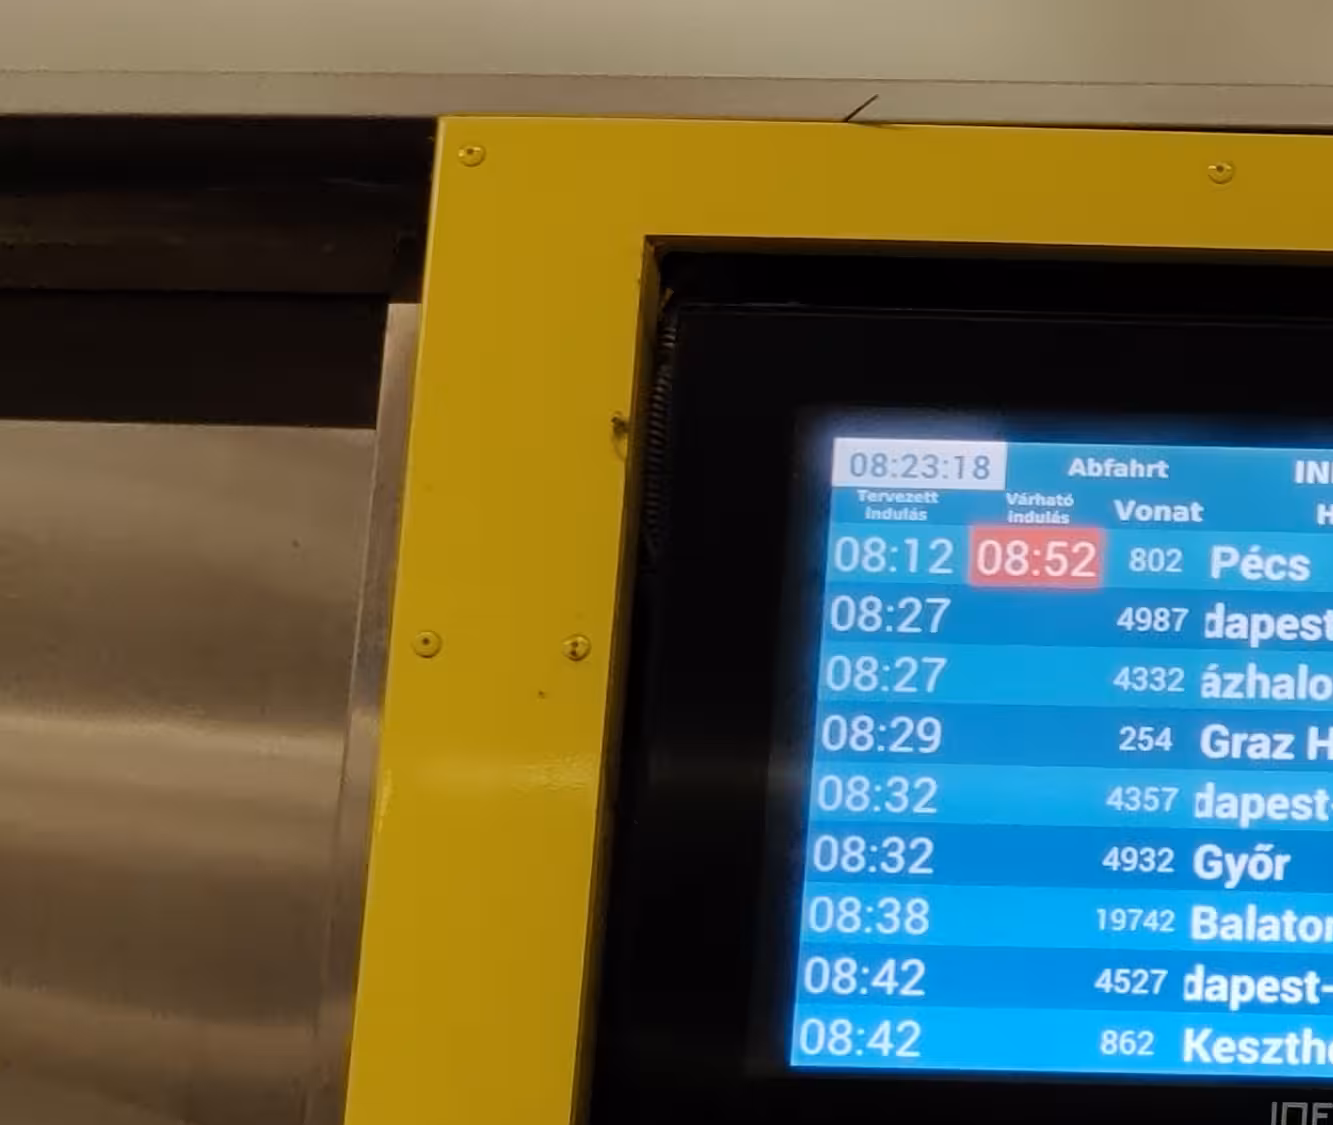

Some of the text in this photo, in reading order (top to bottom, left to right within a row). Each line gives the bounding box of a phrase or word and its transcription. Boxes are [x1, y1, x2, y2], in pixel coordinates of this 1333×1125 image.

[850, 452, 990, 480] 08:23:18
[1068, 457, 1169, 479] Abfahrt
[857, 489, 939, 504] Tervezett
[1006, 491, 1074, 507] Várható
[1114, 500, 1203, 523] Vonat
[834, 537, 953, 574] 08:12
[977, 540, 1096, 578] 08:52
[1129, 548, 1183, 573] 802
[1210, 545, 1311, 581] Pécs
[830, 595, 951, 634] 08:27
[1116, 607, 1189, 633] 4987
[825, 655, 948, 693] 08:27
[1112, 666, 1185, 693] 4332
[821, 714, 942, 754] 08:29
[1118, 727, 1173, 752] 254
[1200, 724, 1295, 760] Graz
[817, 775, 938, 814] 08:32
[1106, 786, 1179, 813] 4357
[813, 835, 934, 875] 08:32
[1102, 847, 1175, 873] 4932
[1193, 842, 1291, 889] Győr
[809, 896, 930, 935] 08:38
[1096, 908, 1175, 933] 19742
[804, 957, 926, 997] 08:42
[1094, 969, 1168, 995] 4527
[800, 1018, 921, 1058] 08:42
[1100, 1031, 1154, 1056] 862
